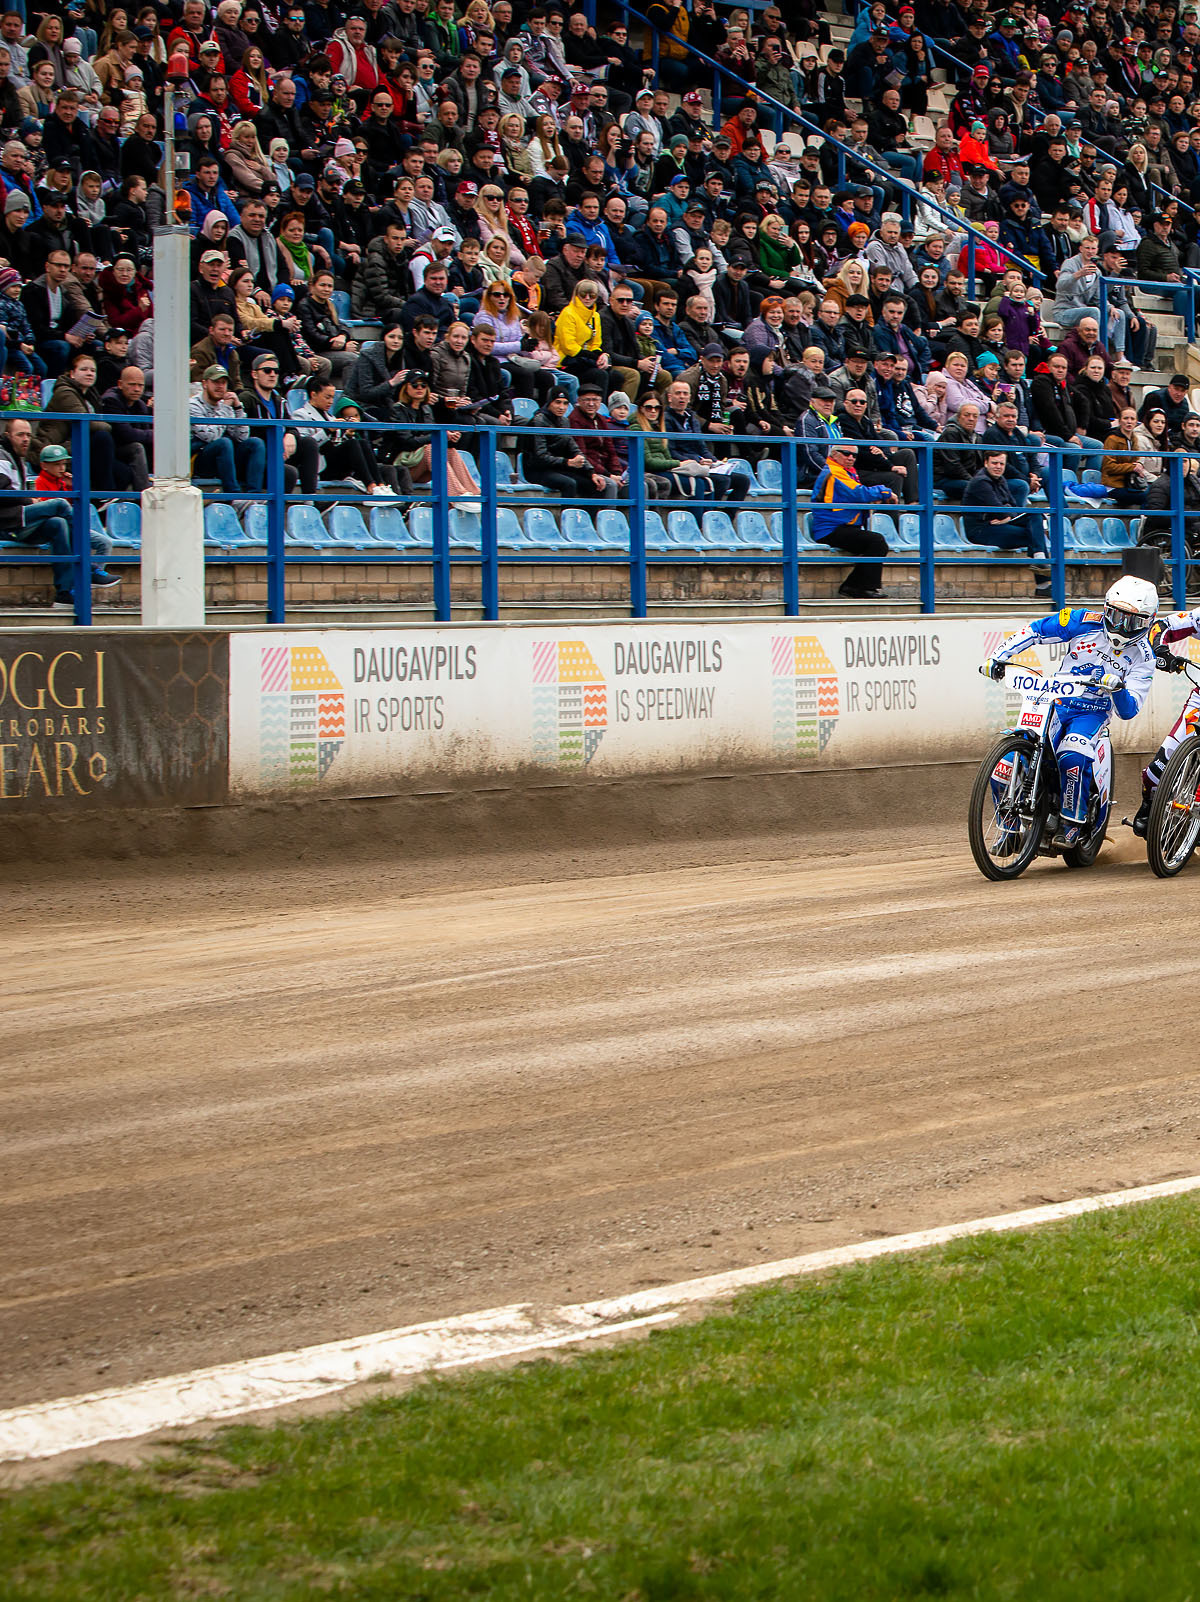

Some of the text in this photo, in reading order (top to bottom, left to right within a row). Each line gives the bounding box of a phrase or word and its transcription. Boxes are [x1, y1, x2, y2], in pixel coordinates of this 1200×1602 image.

[354, 645, 477, 683] DAUGAVPILS
[614, 639, 723, 676] DAUGAVPILS
[844, 635, 941, 668] DAUGAVPILS
[1096, 650, 1127, 677] TEXOM
[1139, 639, 1150, 662] TOLARO
[846, 679, 917, 712] IR SPORTS
[1014, 676, 1075, 695] STOLARO
[354, 695, 444, 733] IR SPORTS
[615, 686, 716, 722] IS SPEEDWAY
[1022, 714, 1042, 722] AMD
[996, 764, 1012, 775] AM
